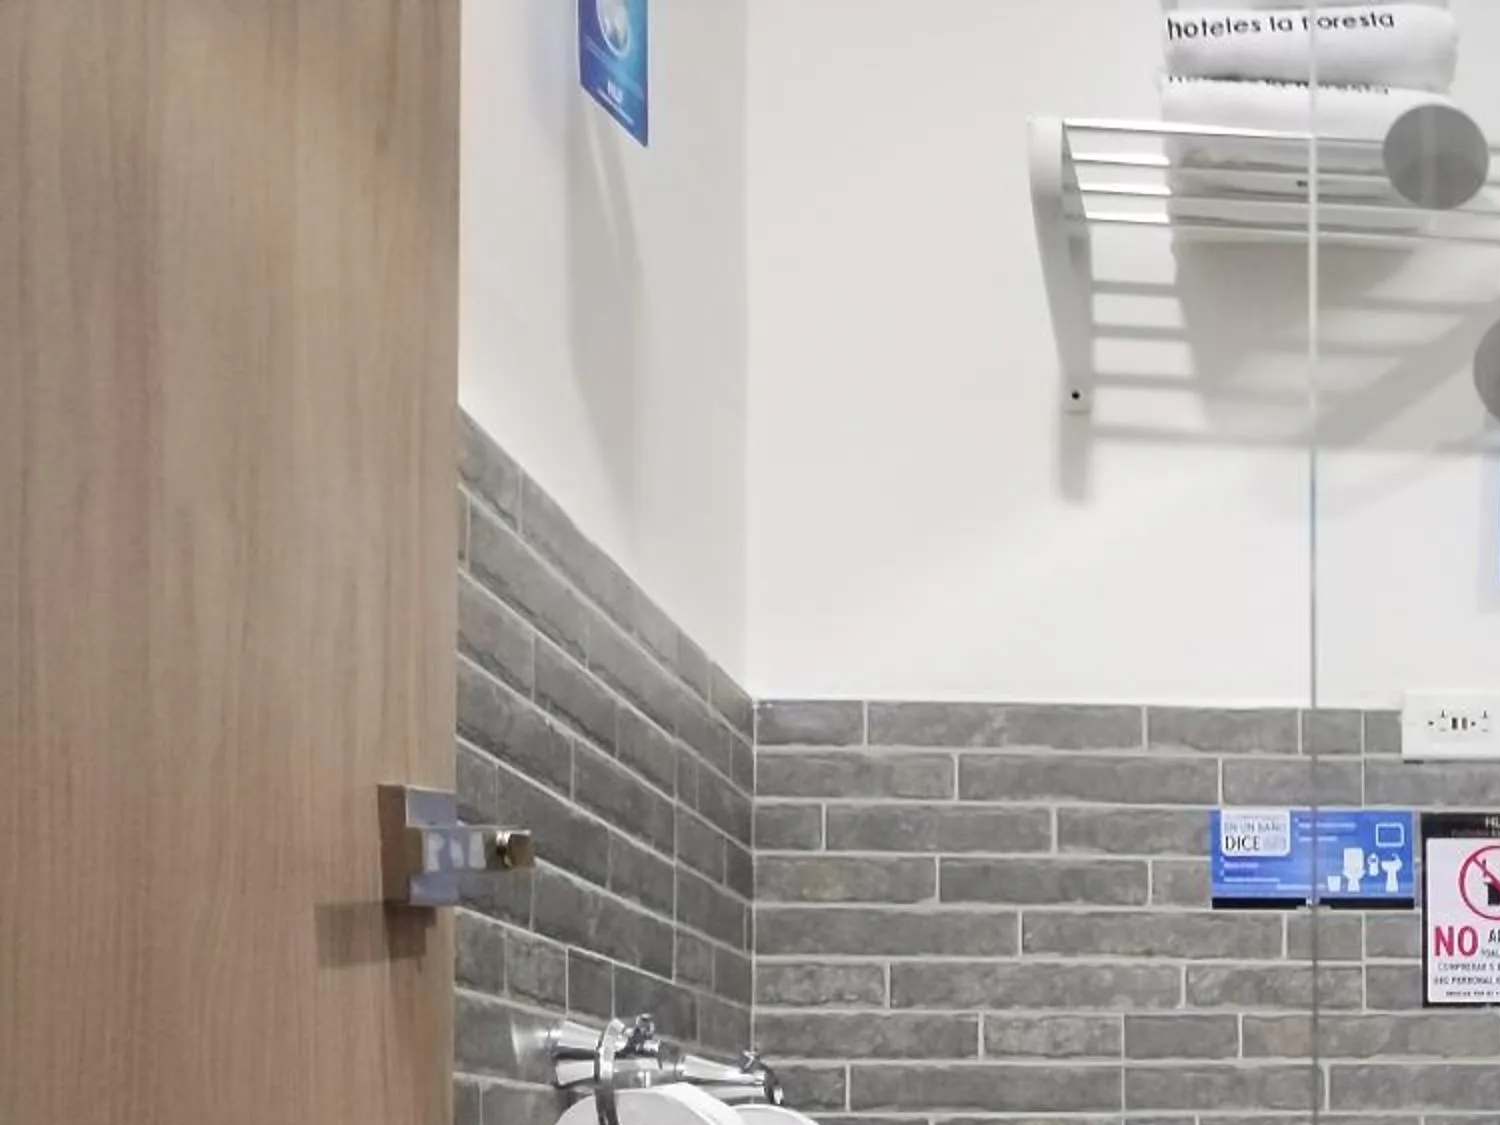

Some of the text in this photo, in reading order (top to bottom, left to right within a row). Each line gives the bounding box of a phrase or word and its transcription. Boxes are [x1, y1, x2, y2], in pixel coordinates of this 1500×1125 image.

[1167, 17, 1261, 40] hoteles
[1270, 16, 1293, 32] la
[1225, 835, 1260, 851] DICE
[1434, 926, 1478, 957] NO
